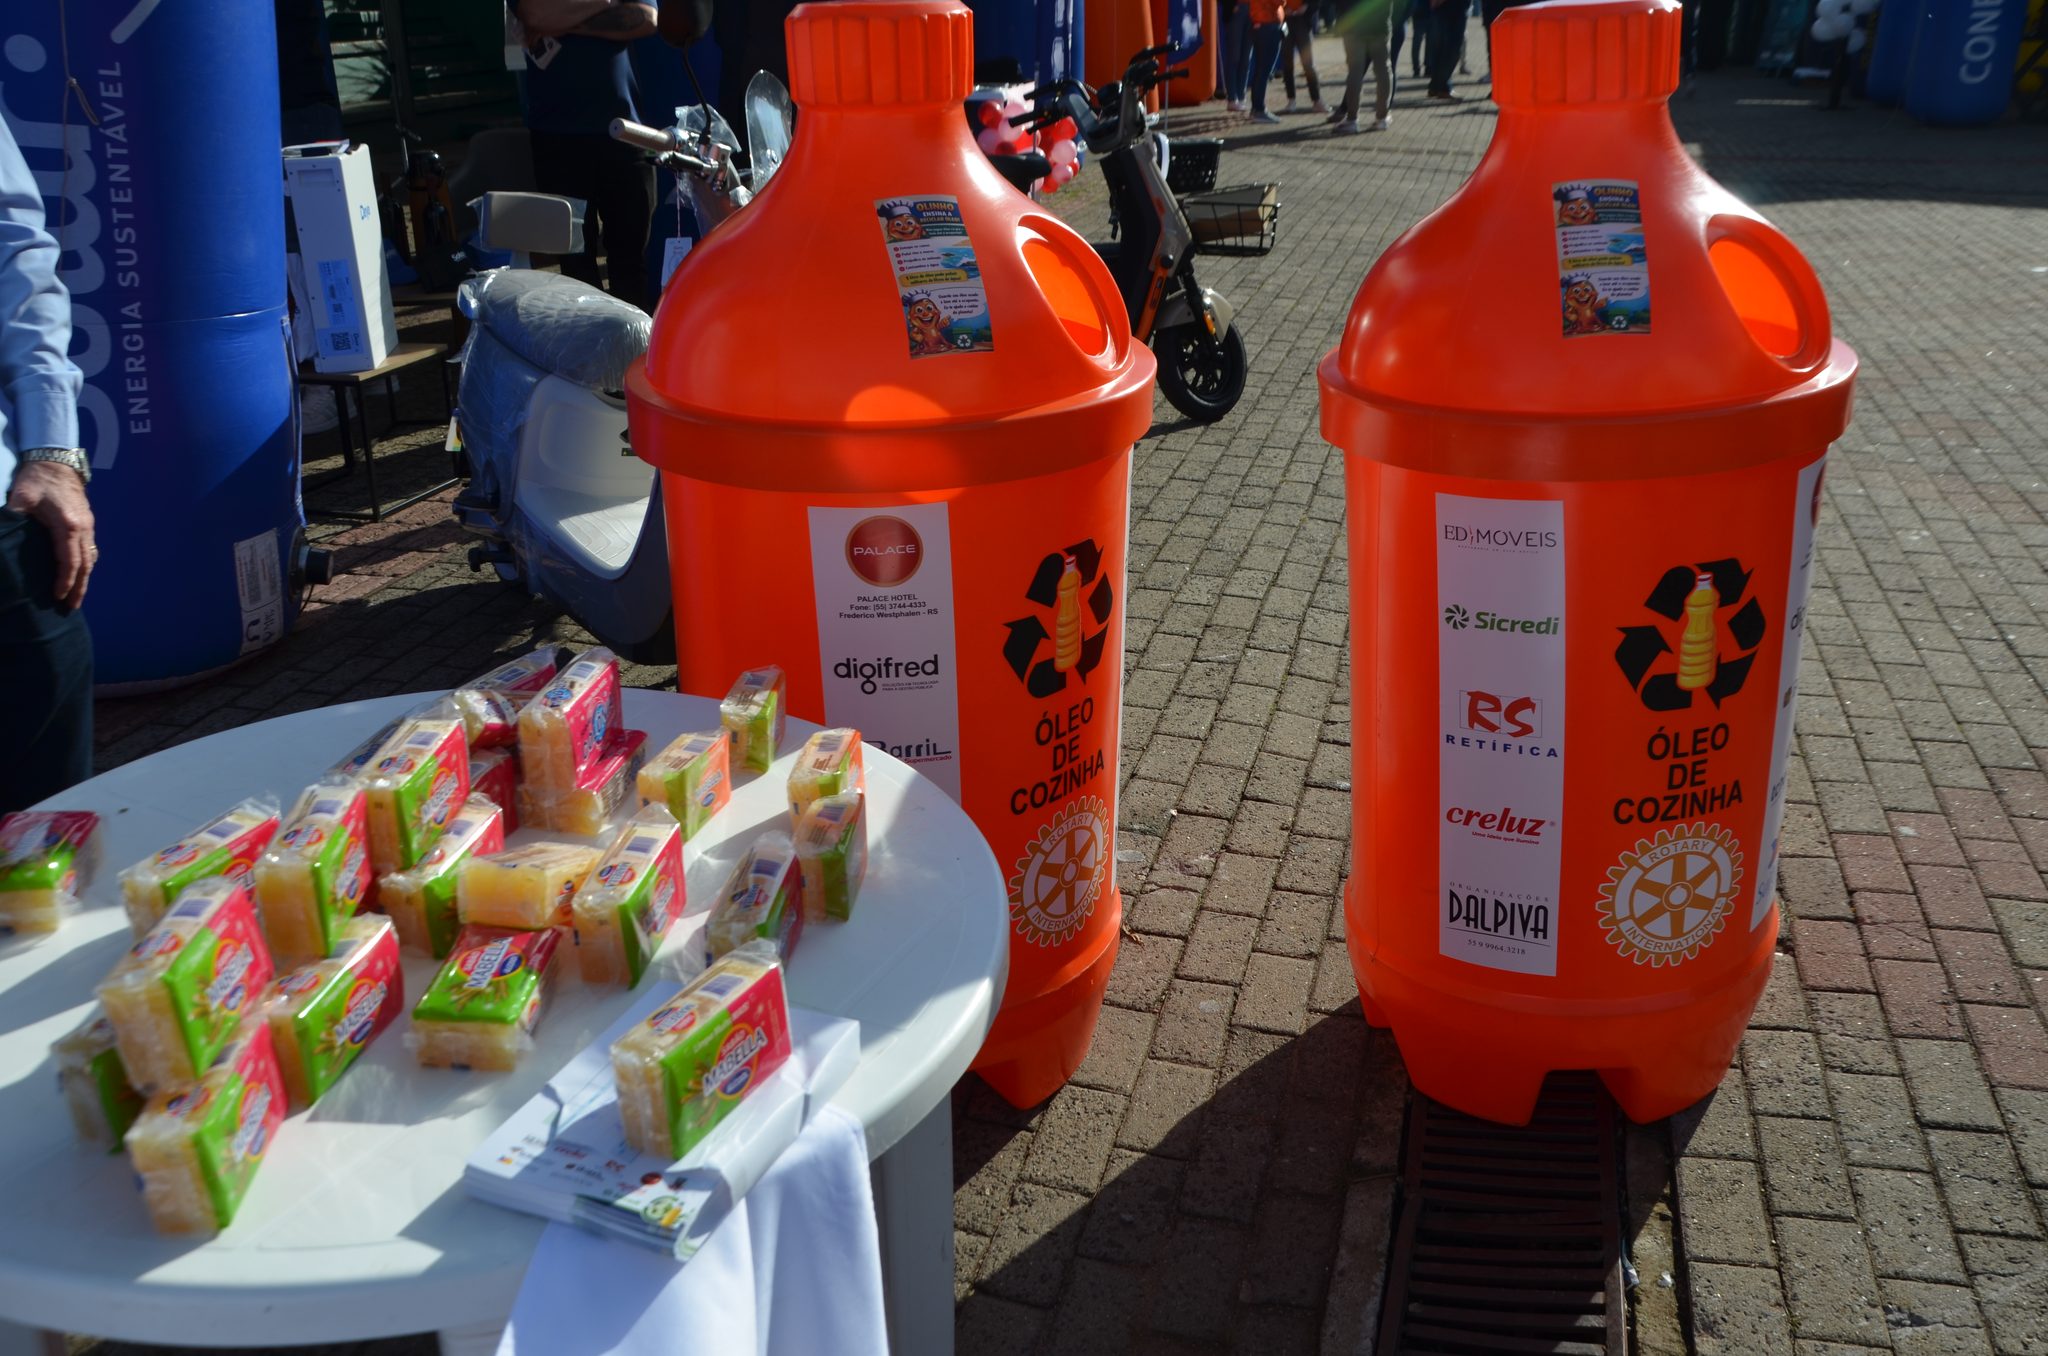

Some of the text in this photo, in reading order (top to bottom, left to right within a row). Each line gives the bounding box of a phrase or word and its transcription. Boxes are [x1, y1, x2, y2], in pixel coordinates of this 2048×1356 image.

[916, 202, 954, 212] OLINHO
[97, 61, 152, 434] ENERGIA SUSTENTÁVEL
[853, 544, 916, 556] PALACE
[839, 612, 875, 620] Frederico
[876, 610, 921, 619] Westphalen
[927, 608, 938, 616] RS
[857, 593, 918, 603] PALACE HOTEL
[889, 601, 927, 610] 3744-4333
[1474, 611, 1560, 635] Sicredi
[833, 653, 940, 695] digifred
[1035, 696, 1094, 746] ÓLEO
[1467, 690, 1537, 738] RS
[1052, 734, 1080, 772] DE
[1445, 734, 1558, 758] RETÍFICA
[1647, 722, 1730, 761] ÓLEO
[904, 755, 952, 764] Supermercado
[1667, 758, 1708, 791] DE
[1010, 749, 1104, 815] COZINHA
[1613, 778, 1744, 825] COZINHA
[1048, 814, 1091, 846] ROTARY
[1446, 807, 1546, 837] creluz
[1649, 839, 1711, 863] ROTARY
[1032, 873, 1098, 930] INTERNATIONAL
[1449, 881, 1549, 902] ORGANIZAÇÕES
[1449, 888, 1549, 940] DALPIVA
[1625, 901, 1725, 951] INTERNATIONAL
[1467, 939, 1477, 947] 55
[462, 935, 513, 990] MABELLA
[702, 1025, 769, 1099] MABELLA
